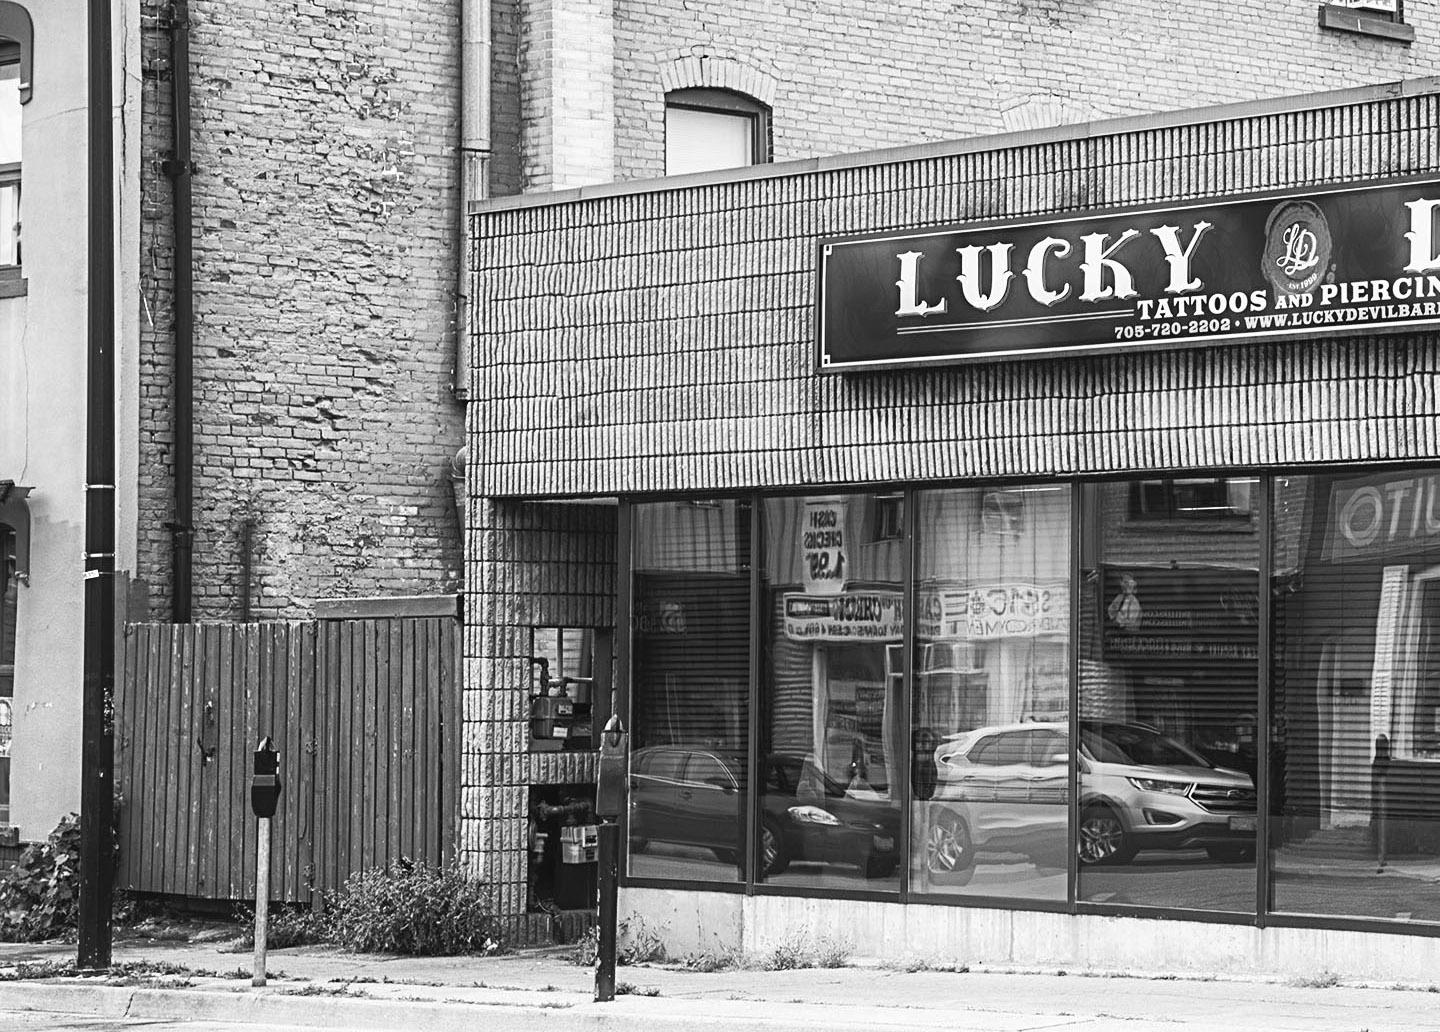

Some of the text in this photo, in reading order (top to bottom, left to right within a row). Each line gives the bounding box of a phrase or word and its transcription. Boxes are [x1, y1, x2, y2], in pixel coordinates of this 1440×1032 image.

[895, 220, 1214, 317] LUCKY
[1137, 290, 1267, 320] TATTOOS
[1275, 293, 1313, 310] AND
[1115, 318, 1231, 339] 705-720-2202
